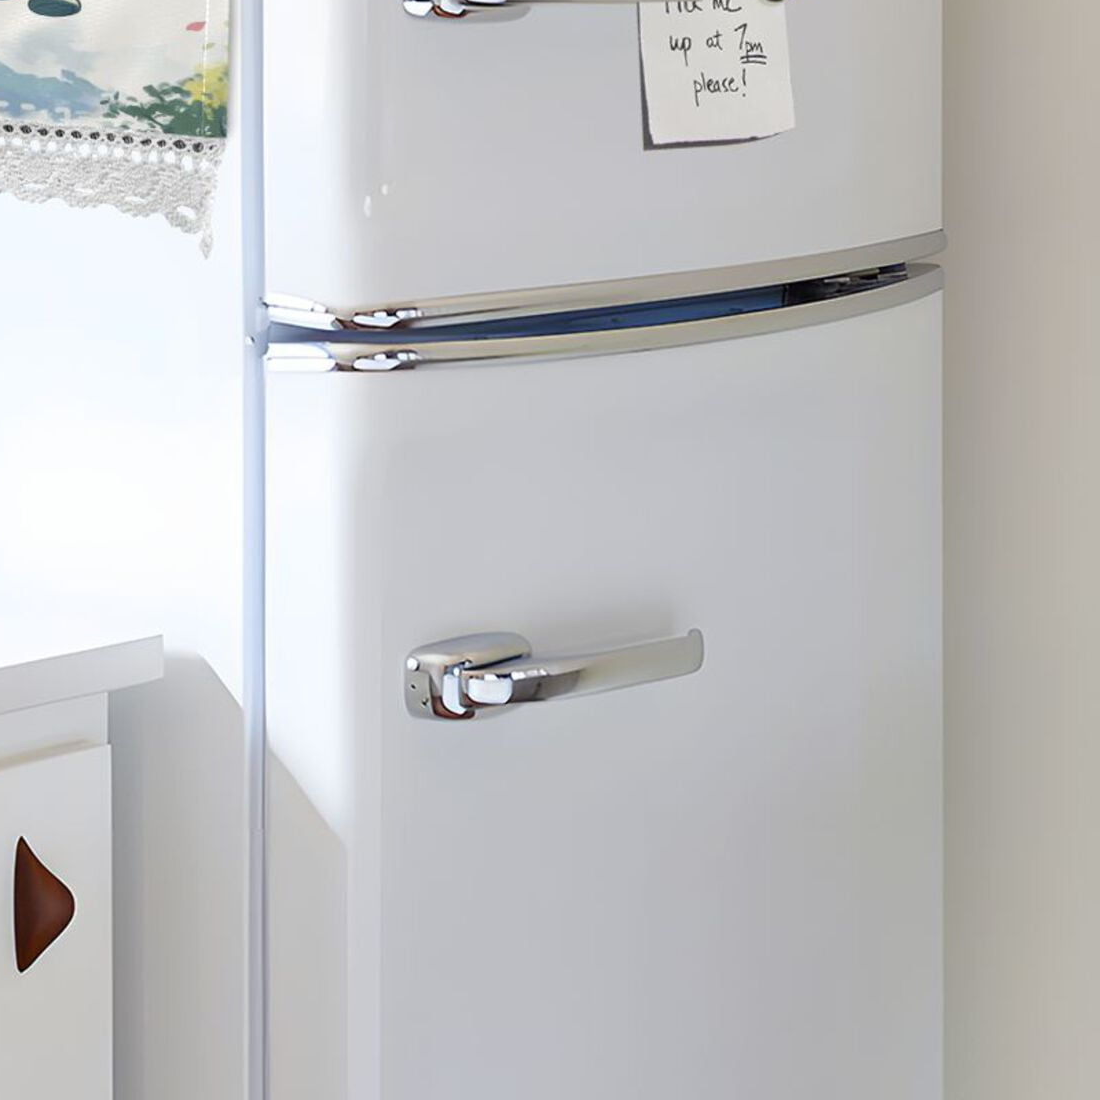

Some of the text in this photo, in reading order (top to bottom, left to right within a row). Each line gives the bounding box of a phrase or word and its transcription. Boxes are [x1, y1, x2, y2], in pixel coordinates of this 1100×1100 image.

[669, 35, 692, 67] up
[706, 30, 723, 50] at
[693, 68, 747, 107] please!
